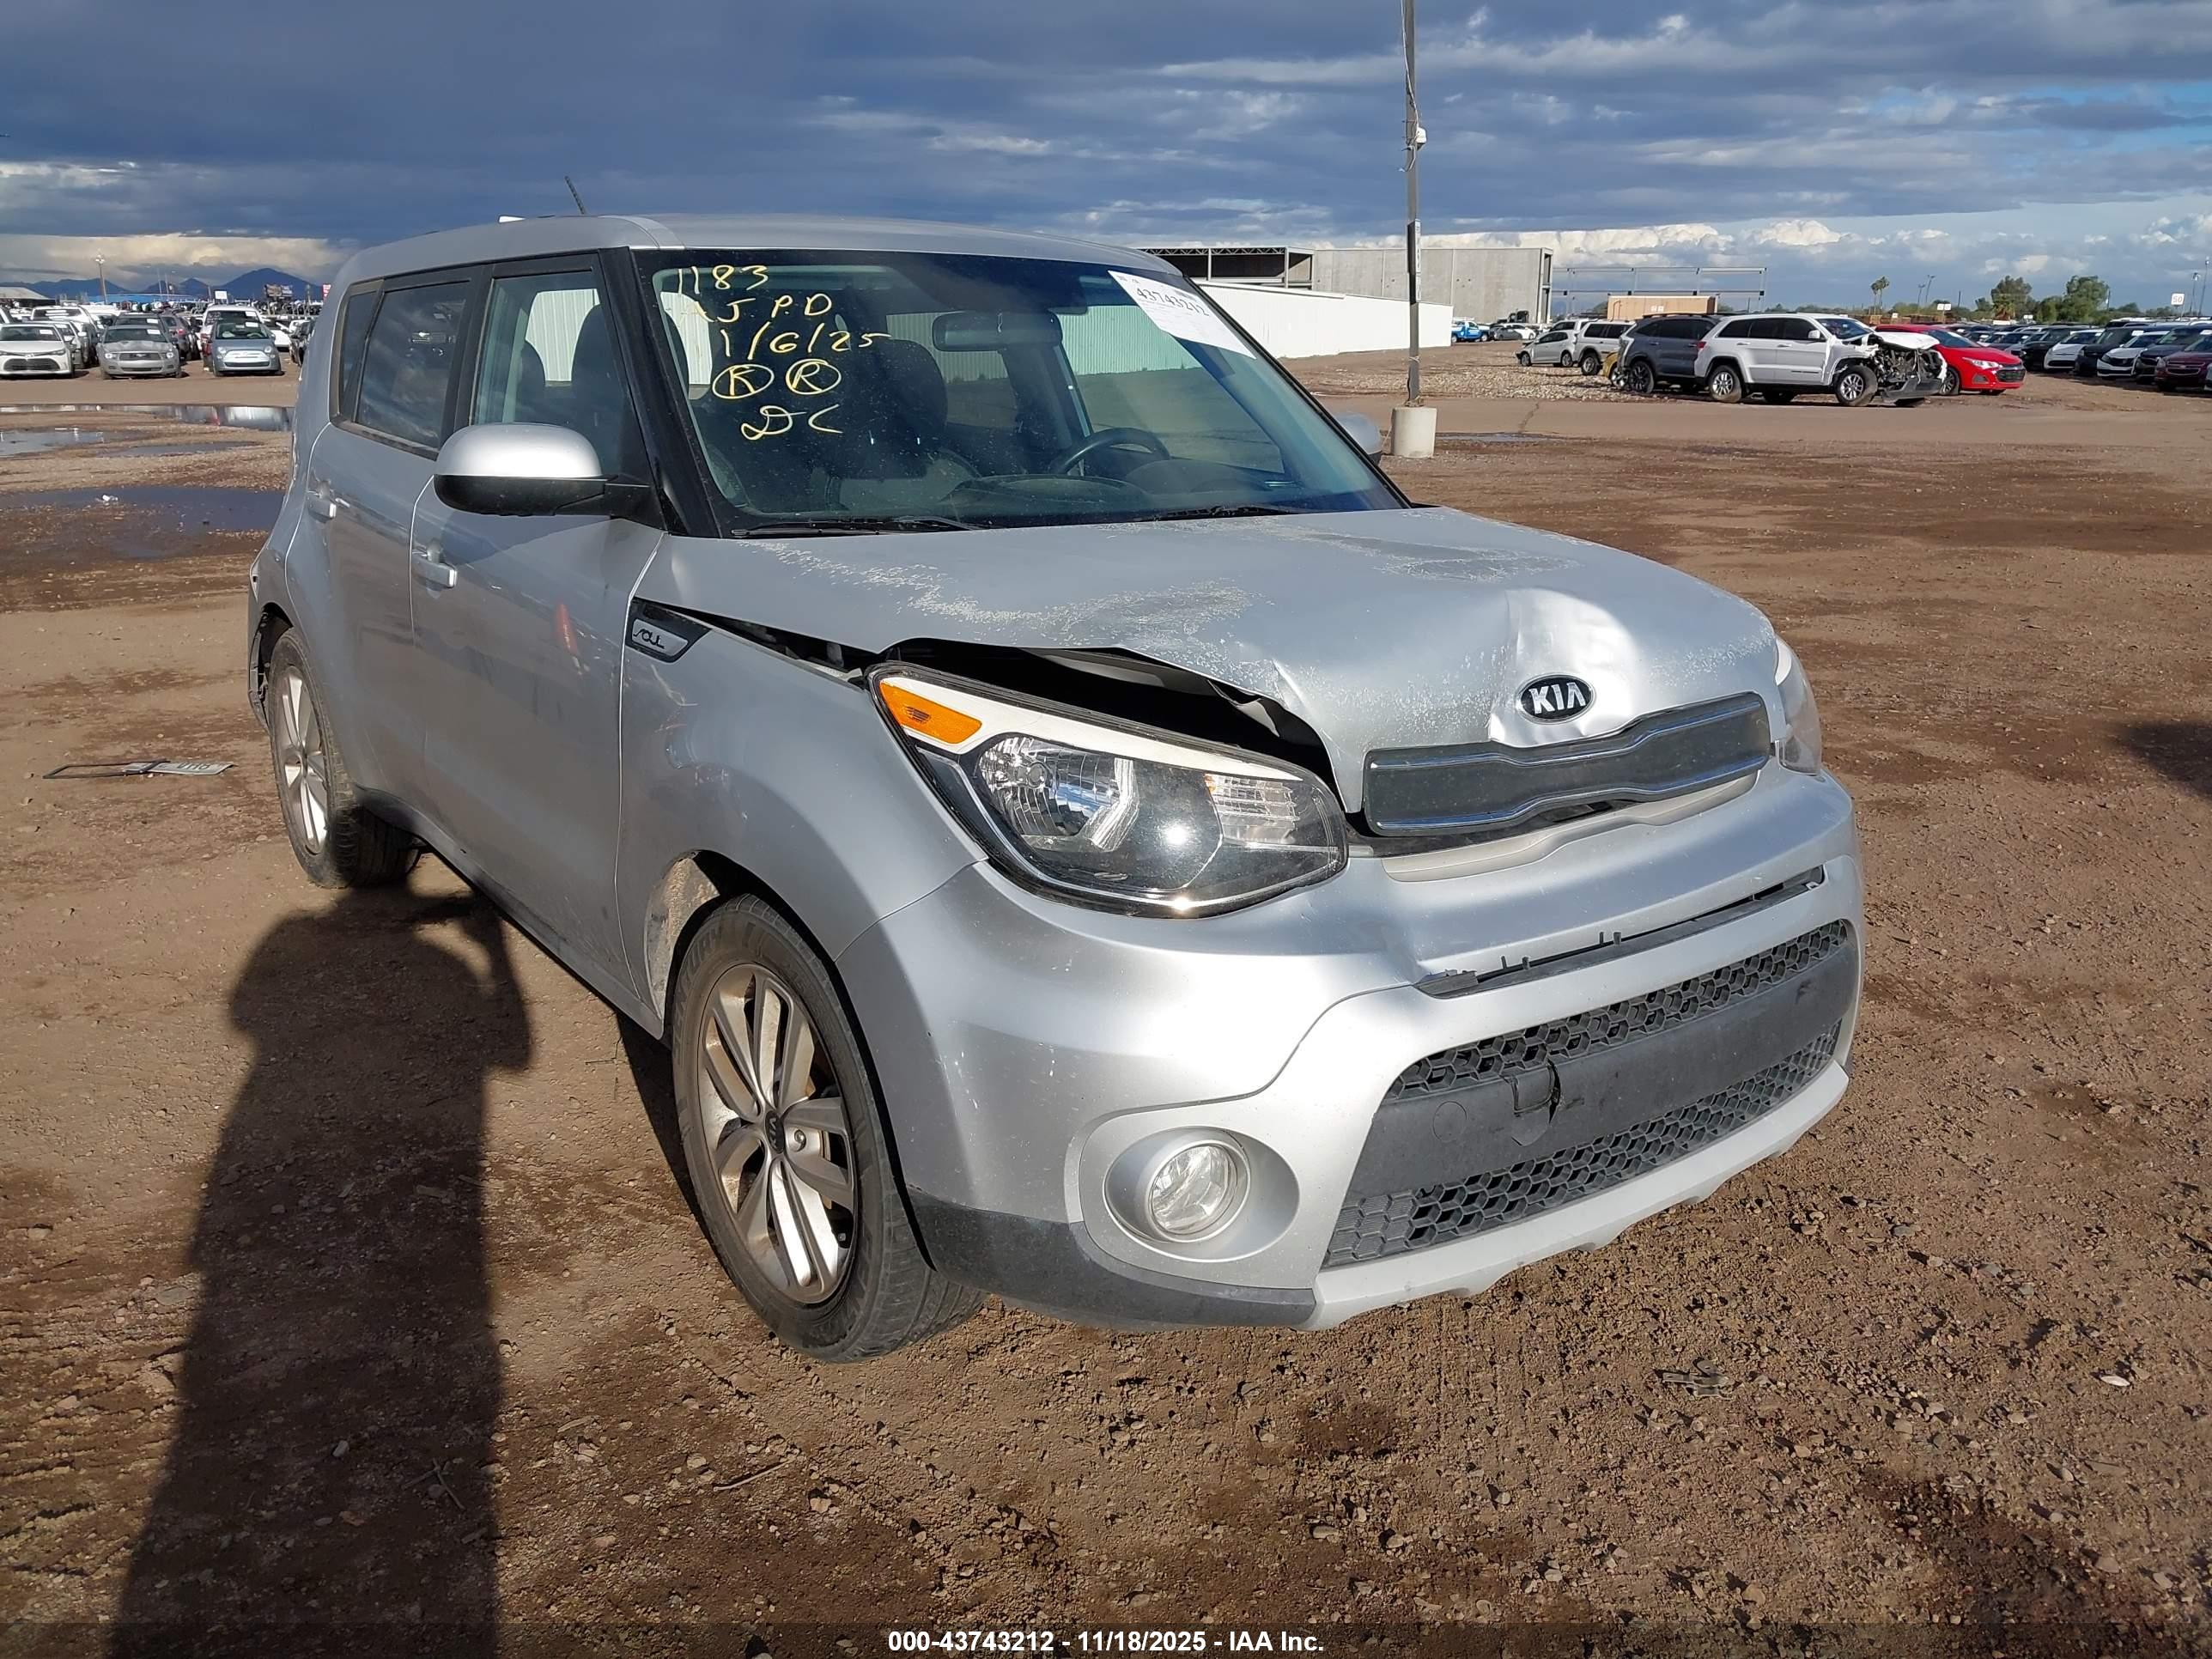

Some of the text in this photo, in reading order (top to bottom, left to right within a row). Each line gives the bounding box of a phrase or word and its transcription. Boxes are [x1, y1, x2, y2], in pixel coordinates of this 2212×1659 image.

[678, 264, 768, 295] 1183
[1137, 288, 1209, 317] 43743212
[1528, 682, 1586, 714] KIA
